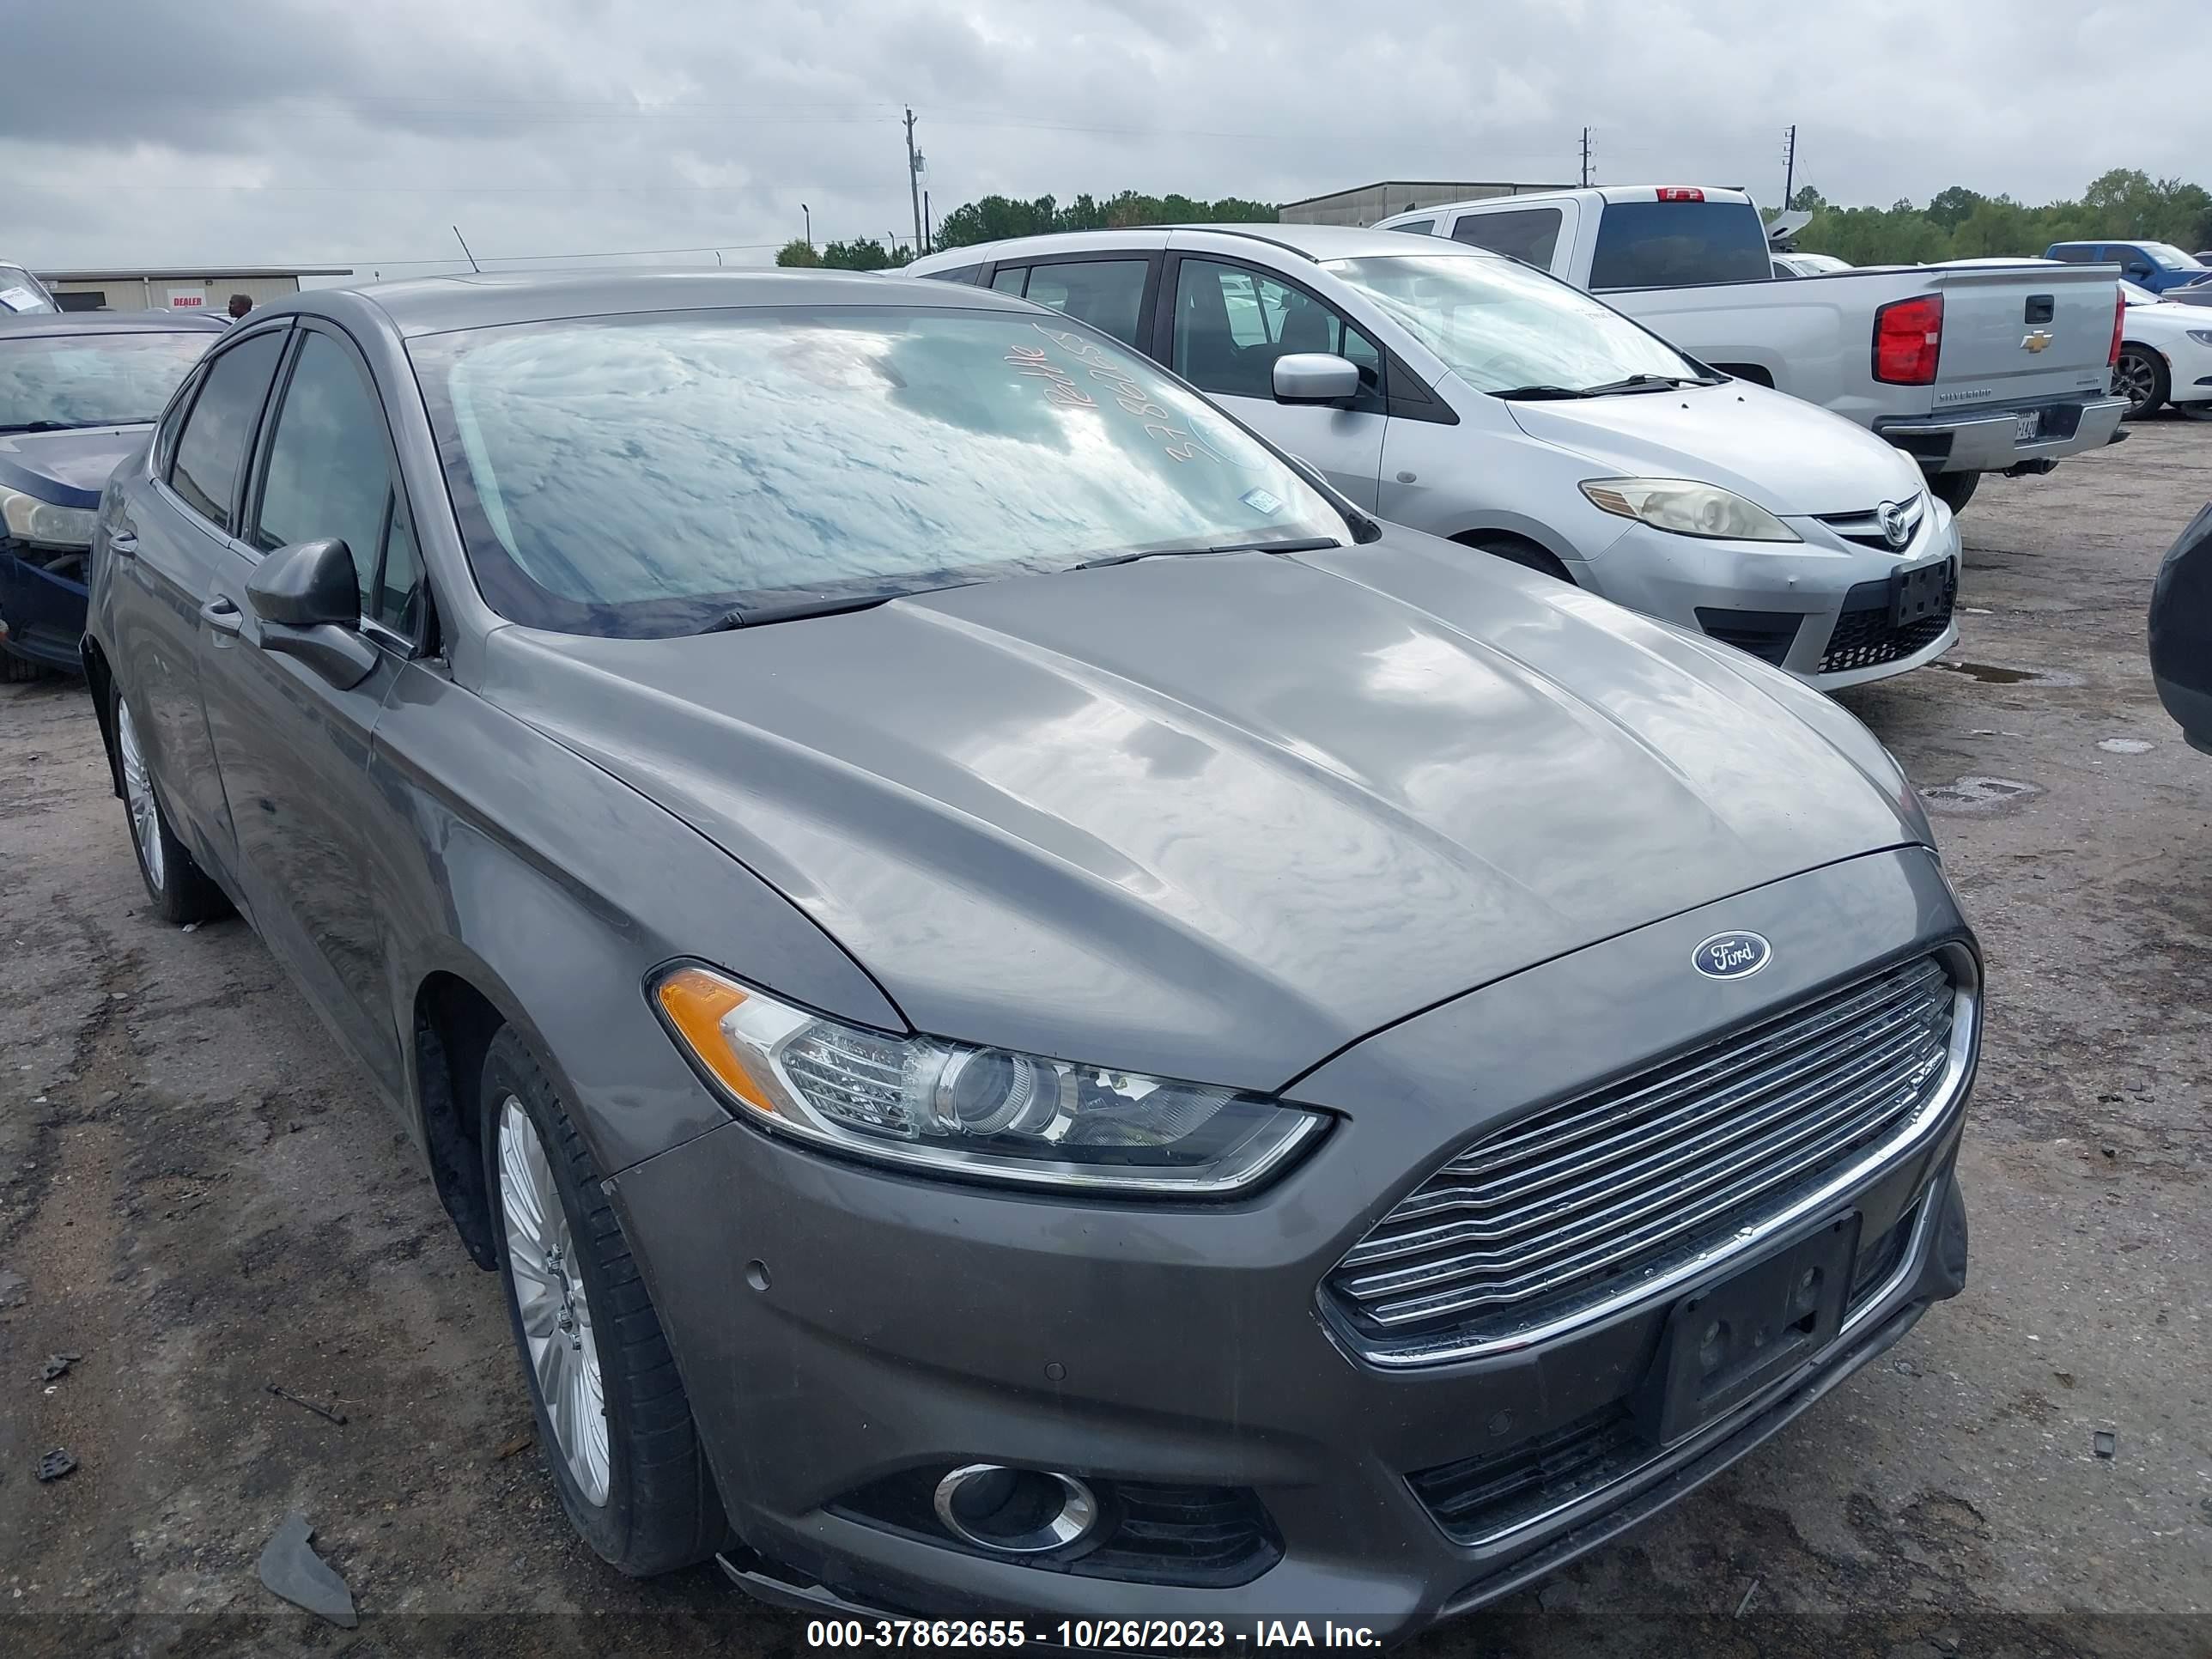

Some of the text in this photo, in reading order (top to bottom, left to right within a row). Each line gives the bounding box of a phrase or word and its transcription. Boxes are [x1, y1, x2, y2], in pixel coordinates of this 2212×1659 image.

[173, 297, 203, 307] DEALER
[1031, 322, 1220, 464] 37862655
[1939, 388, 1992, 402] SILVERADO
[1711, 940, 1755, 970] Ford
